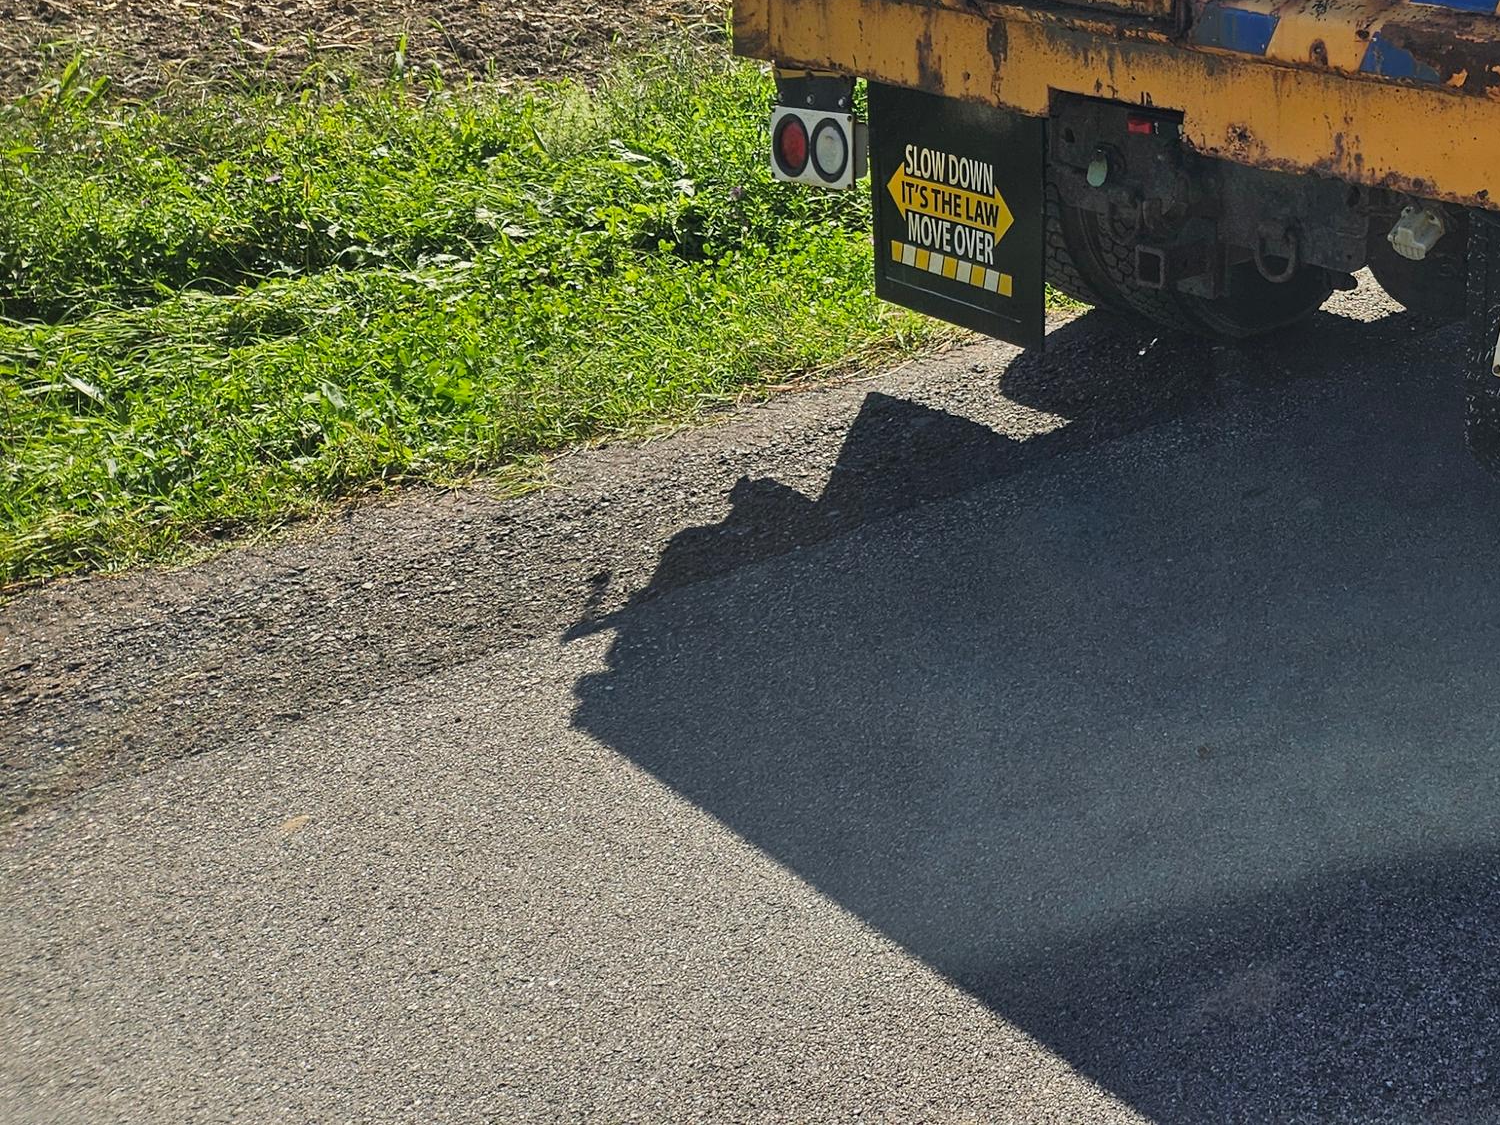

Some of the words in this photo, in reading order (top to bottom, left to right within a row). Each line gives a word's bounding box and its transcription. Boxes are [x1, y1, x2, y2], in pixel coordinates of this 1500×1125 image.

[905, 144, 945, 181] SLOW
[949, 154, 993, 195] DOWN
[902, 181, 928, 208] IT'S
[931, 190, 961, 217] THE
[966, 197, 999, 227] LAW
[908, 212, 950, 252] MOVE
[954, 225, 993, 265] OVER
